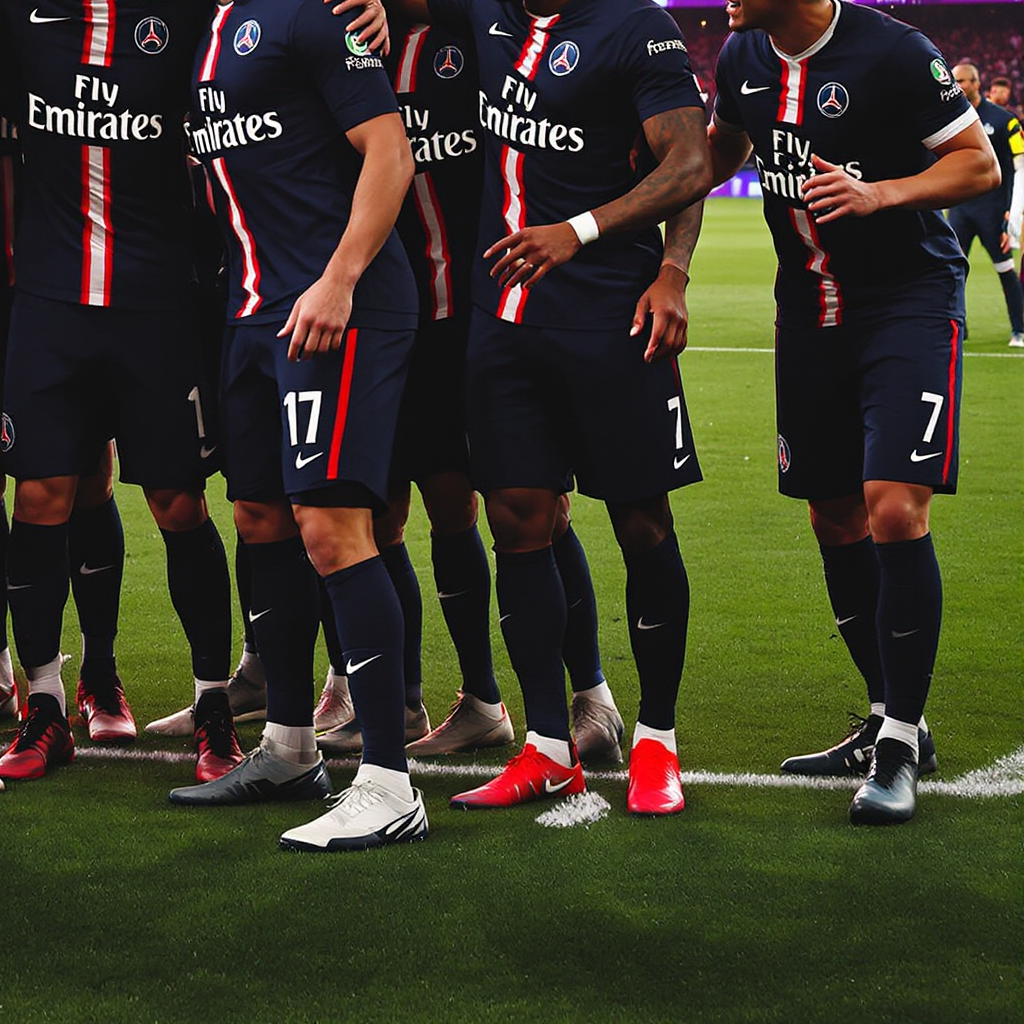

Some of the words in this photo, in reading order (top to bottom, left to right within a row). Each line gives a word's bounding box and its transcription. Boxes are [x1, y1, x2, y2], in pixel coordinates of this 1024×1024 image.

[74, 74, 119, 108] Fly
[197, 86, 226, 114] Fly
[501, 76, 537, 112] Fly
[28, 91, 163, 141] Emirates
[399, 105, 429, 131] ly
[772, 129, 811, 167] Fly
[187, 386, 205, 438] 1
[283, 390, 323, 447] 17
[920, 391, 945, 443] 7
